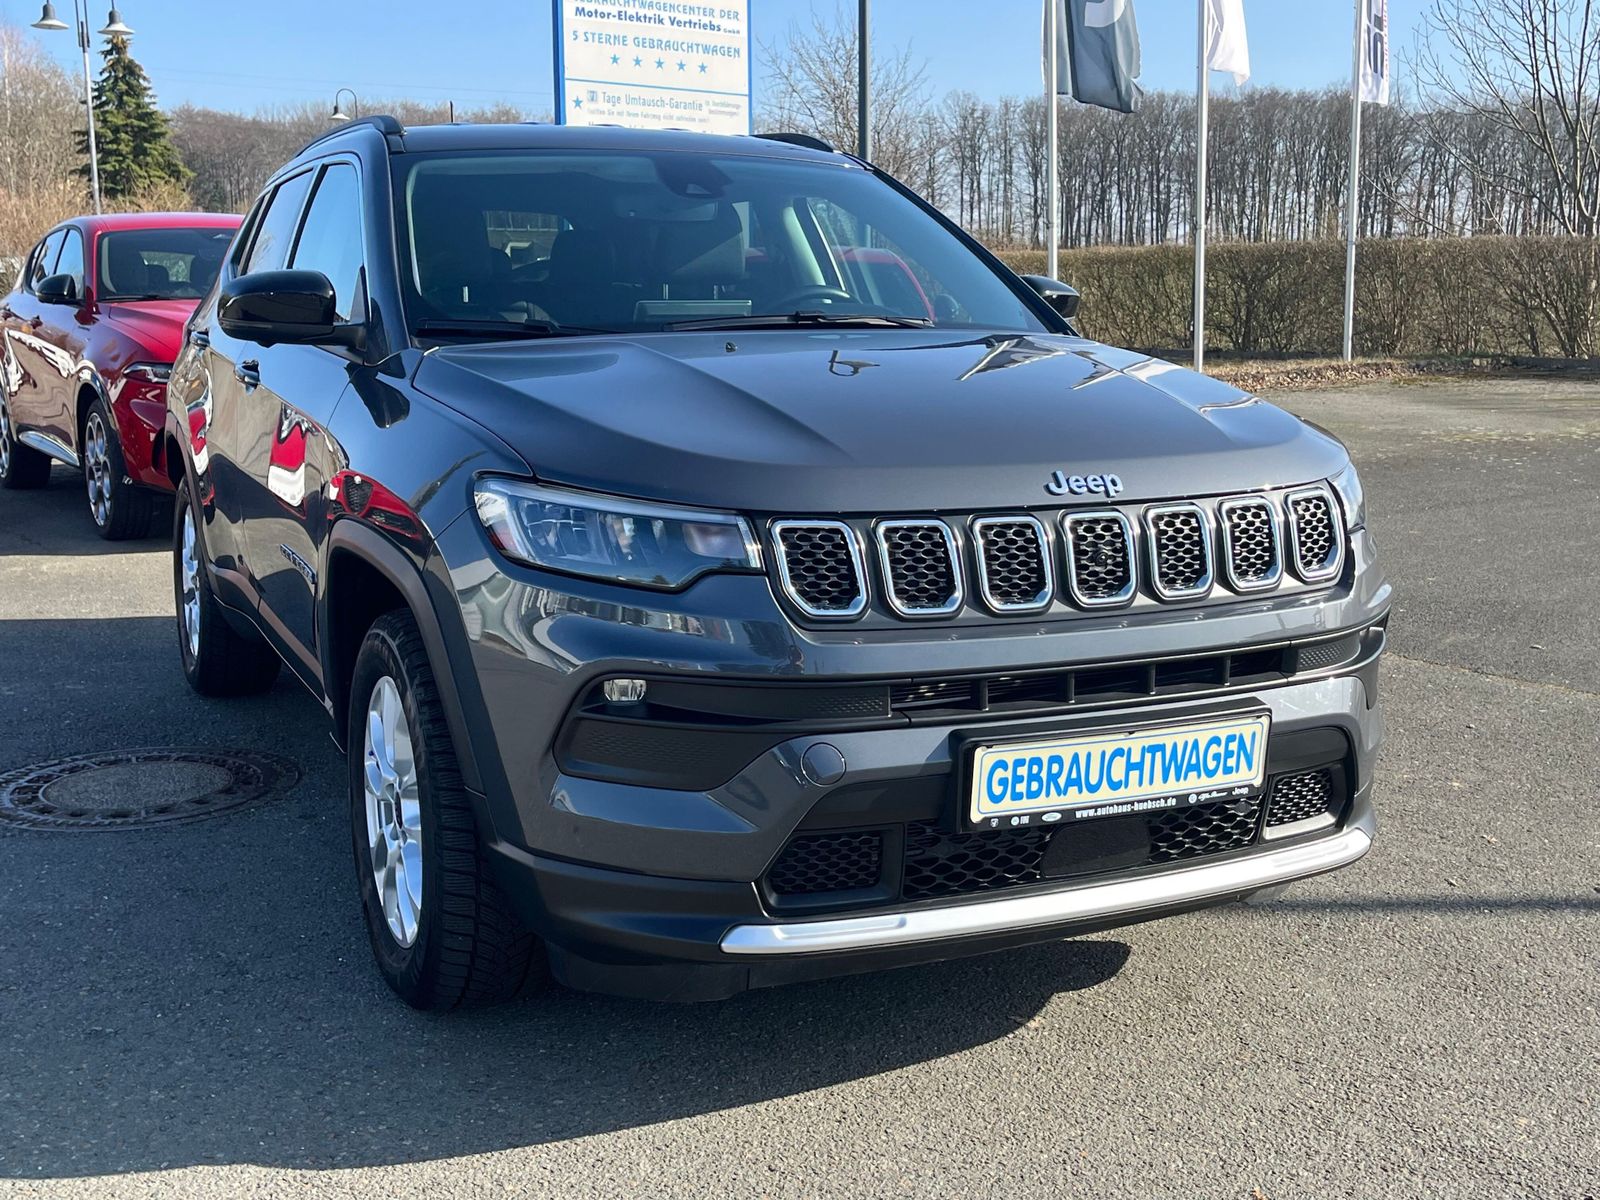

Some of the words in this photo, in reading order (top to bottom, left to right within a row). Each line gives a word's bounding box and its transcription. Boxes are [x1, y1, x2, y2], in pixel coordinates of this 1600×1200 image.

[574, 0, 715, 18] RAUCHTWAGENCENTER
[719, 9, 740, 21] DER
[575, 6, 665, 25] Motor-Elektrik
[668, 16, 722, 32] Vertriebs
[572, 30, 579, 41] 5
[583, 31, 628, 46] STERNE
[633, 36, 740, 59] GEBRAUCHTWAGEN
[602, 91, 621, 107] Tage
[625, 94, 703, 111] Umtausch-Garantie
[1044, 470, 1124, 498] Jeep
[986, 731, 1257, 804] GEBRAUCHTWAGEN
[1075, 797, 1177, 819] www.autohaus-huebsch.de
